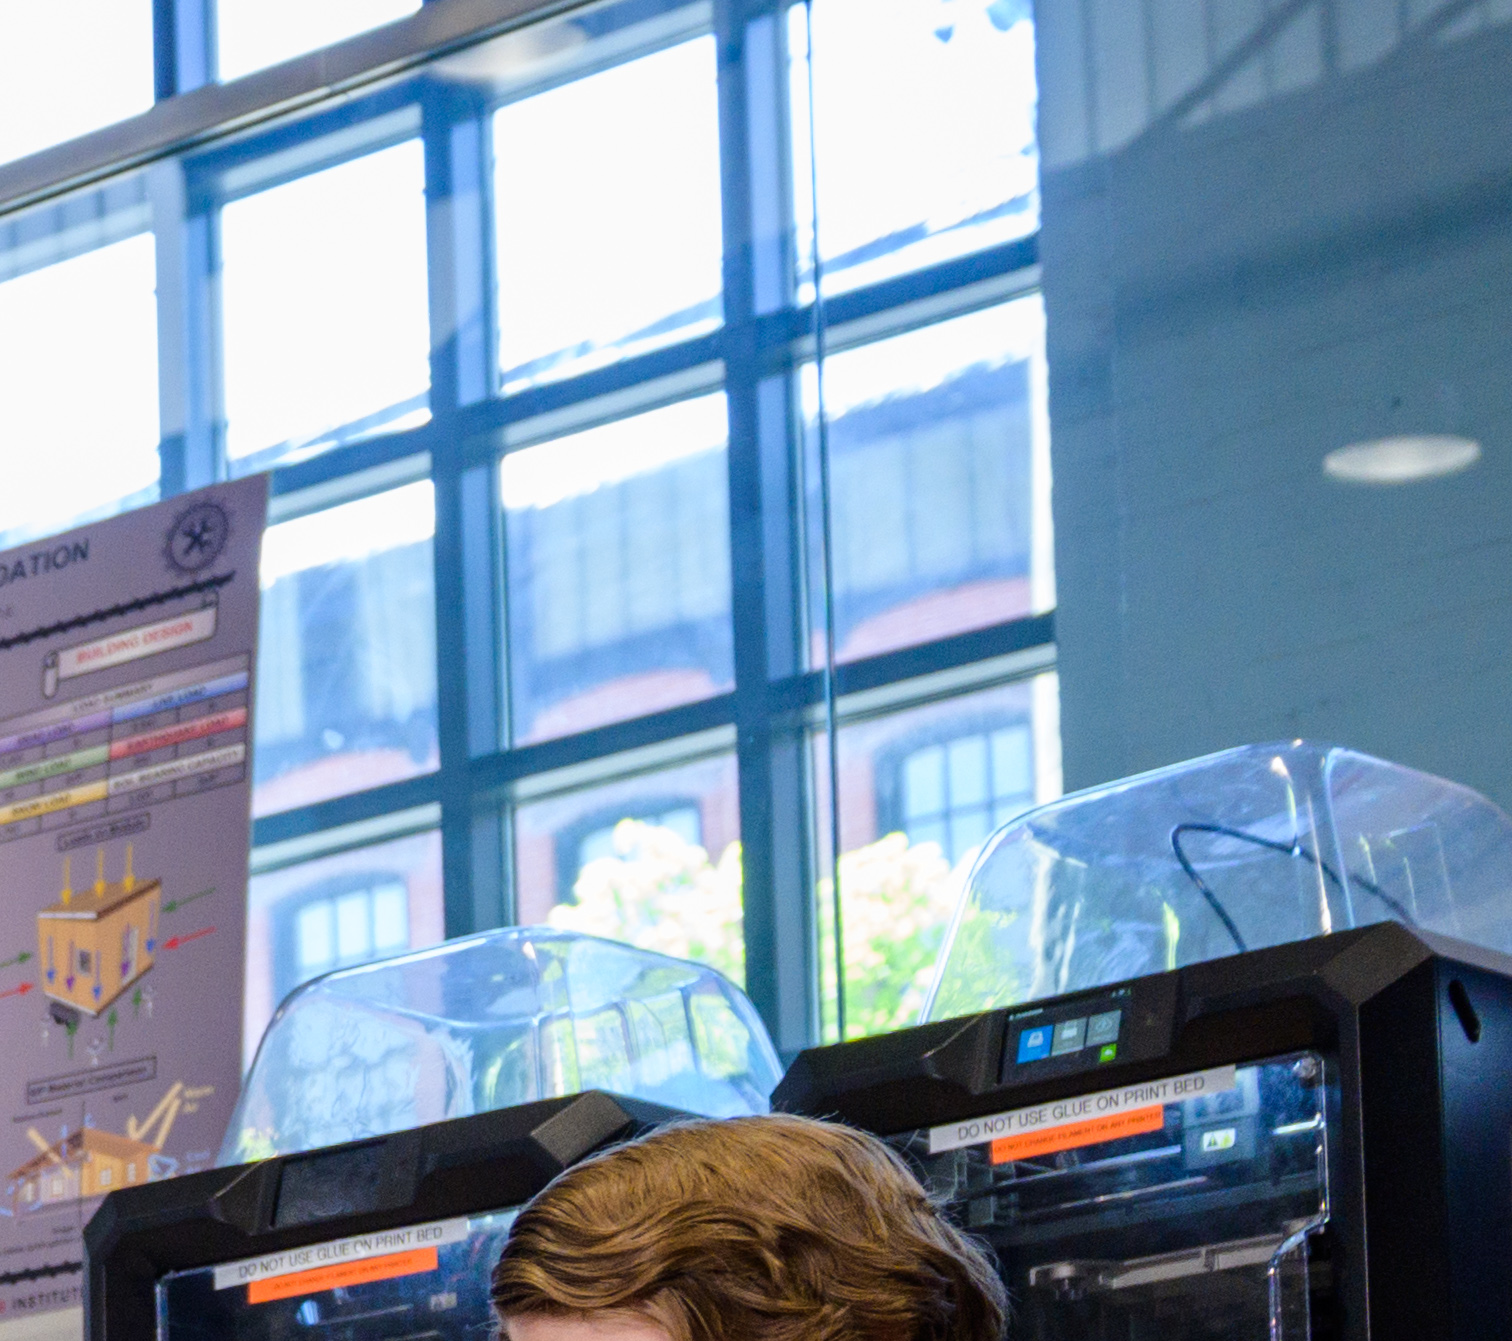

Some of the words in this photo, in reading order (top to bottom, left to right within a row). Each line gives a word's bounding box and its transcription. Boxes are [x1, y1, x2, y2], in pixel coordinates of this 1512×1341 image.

[957, 1122, 980, 1141] DO
[983, 1116, 1014, 1136] NOT
[1018, 1107, 1047, 1128] USE
[1052, 1099, 1091, 1120] GLUE
[1096, 1094, 1119, 1111] ON
[1123, 1083, 1168, 1106] PRINT
[1173, 1075, 1205, 1095] BED
[238, 1264, 256, 1279] DO
[260, 1256, 285, 1273] NOT
[289, 1250, 313, 1267] USE
[317, 1242, 351, 1261] GLUE
[353, 1236, 373, 1255] ON
[376, 1231, 412, 1249] PRINT
[416, 1226, 443, 1242] BED
[12, 1285, 84, 1310] INSTITUT
